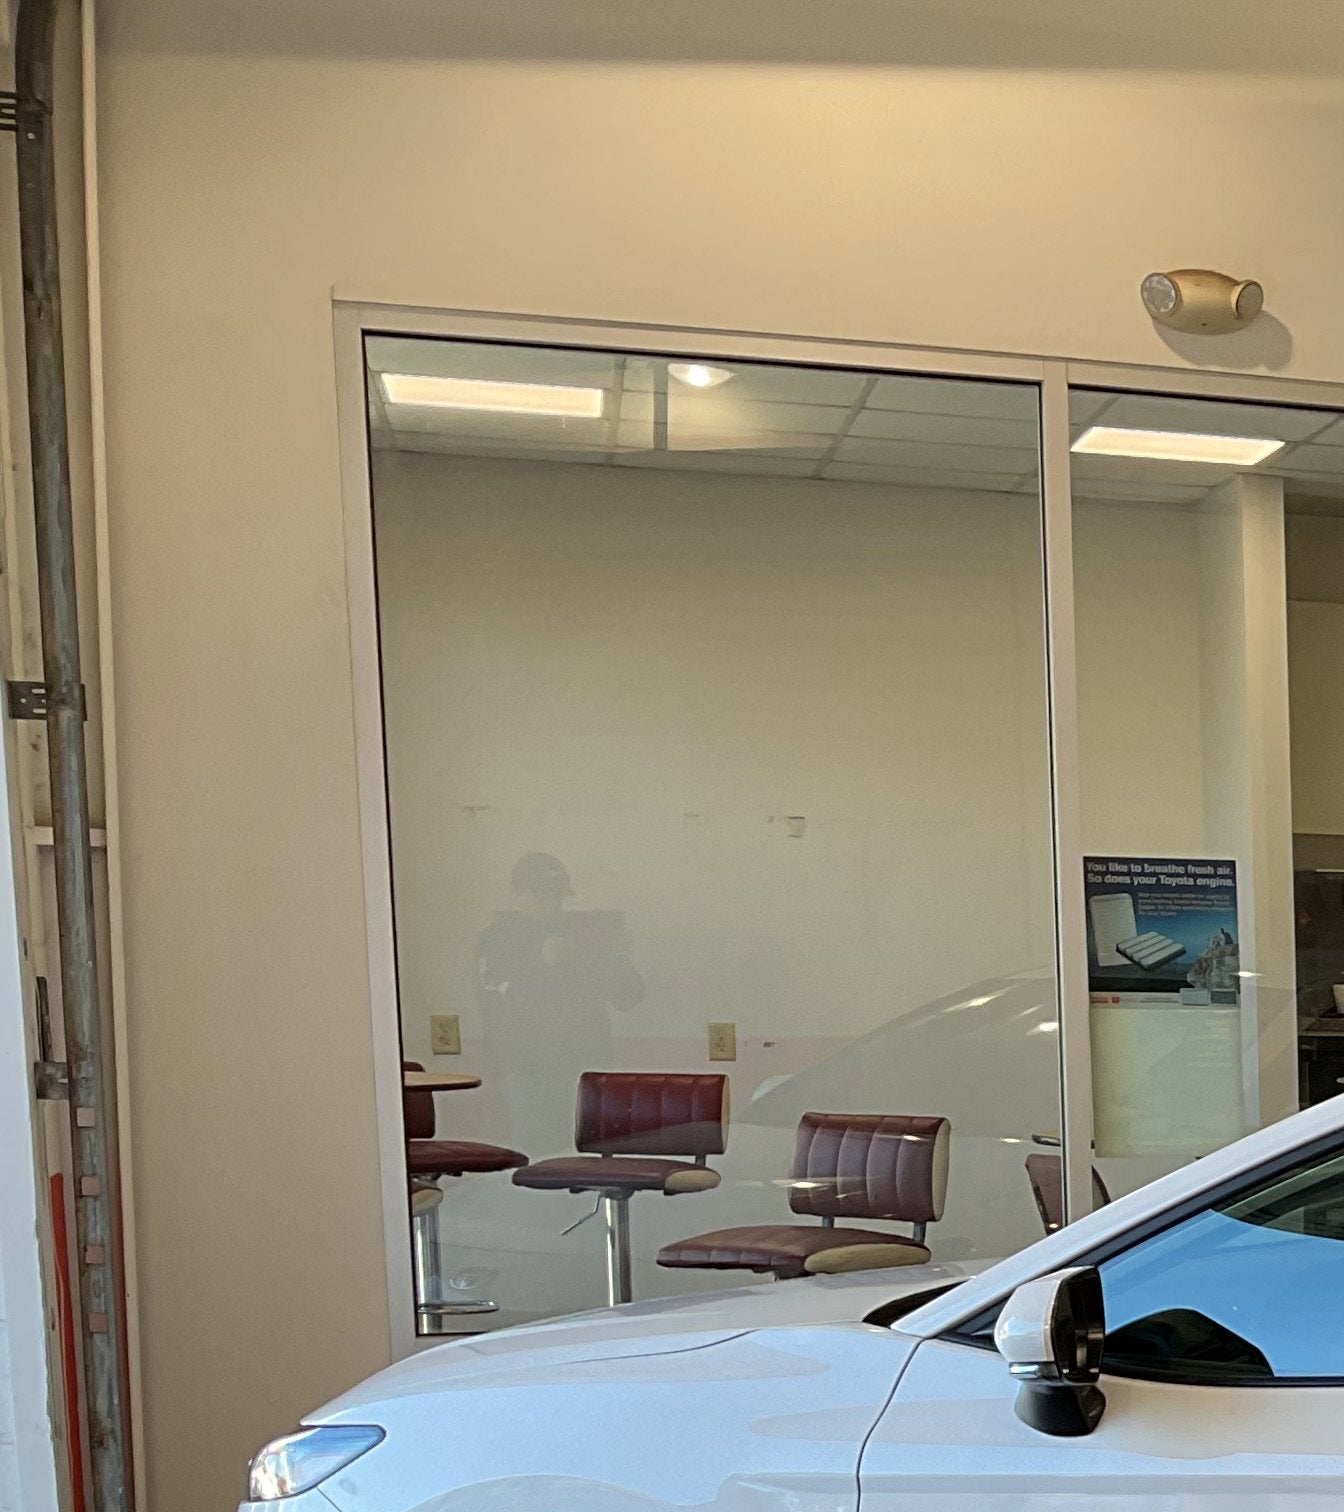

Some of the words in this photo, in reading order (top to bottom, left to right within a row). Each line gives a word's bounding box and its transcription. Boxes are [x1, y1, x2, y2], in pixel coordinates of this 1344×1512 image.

[1131, 864, 1142, 873] to
[1133, 876, 1156, 886] your
[1159, 875, 1194, 887] Toyota
